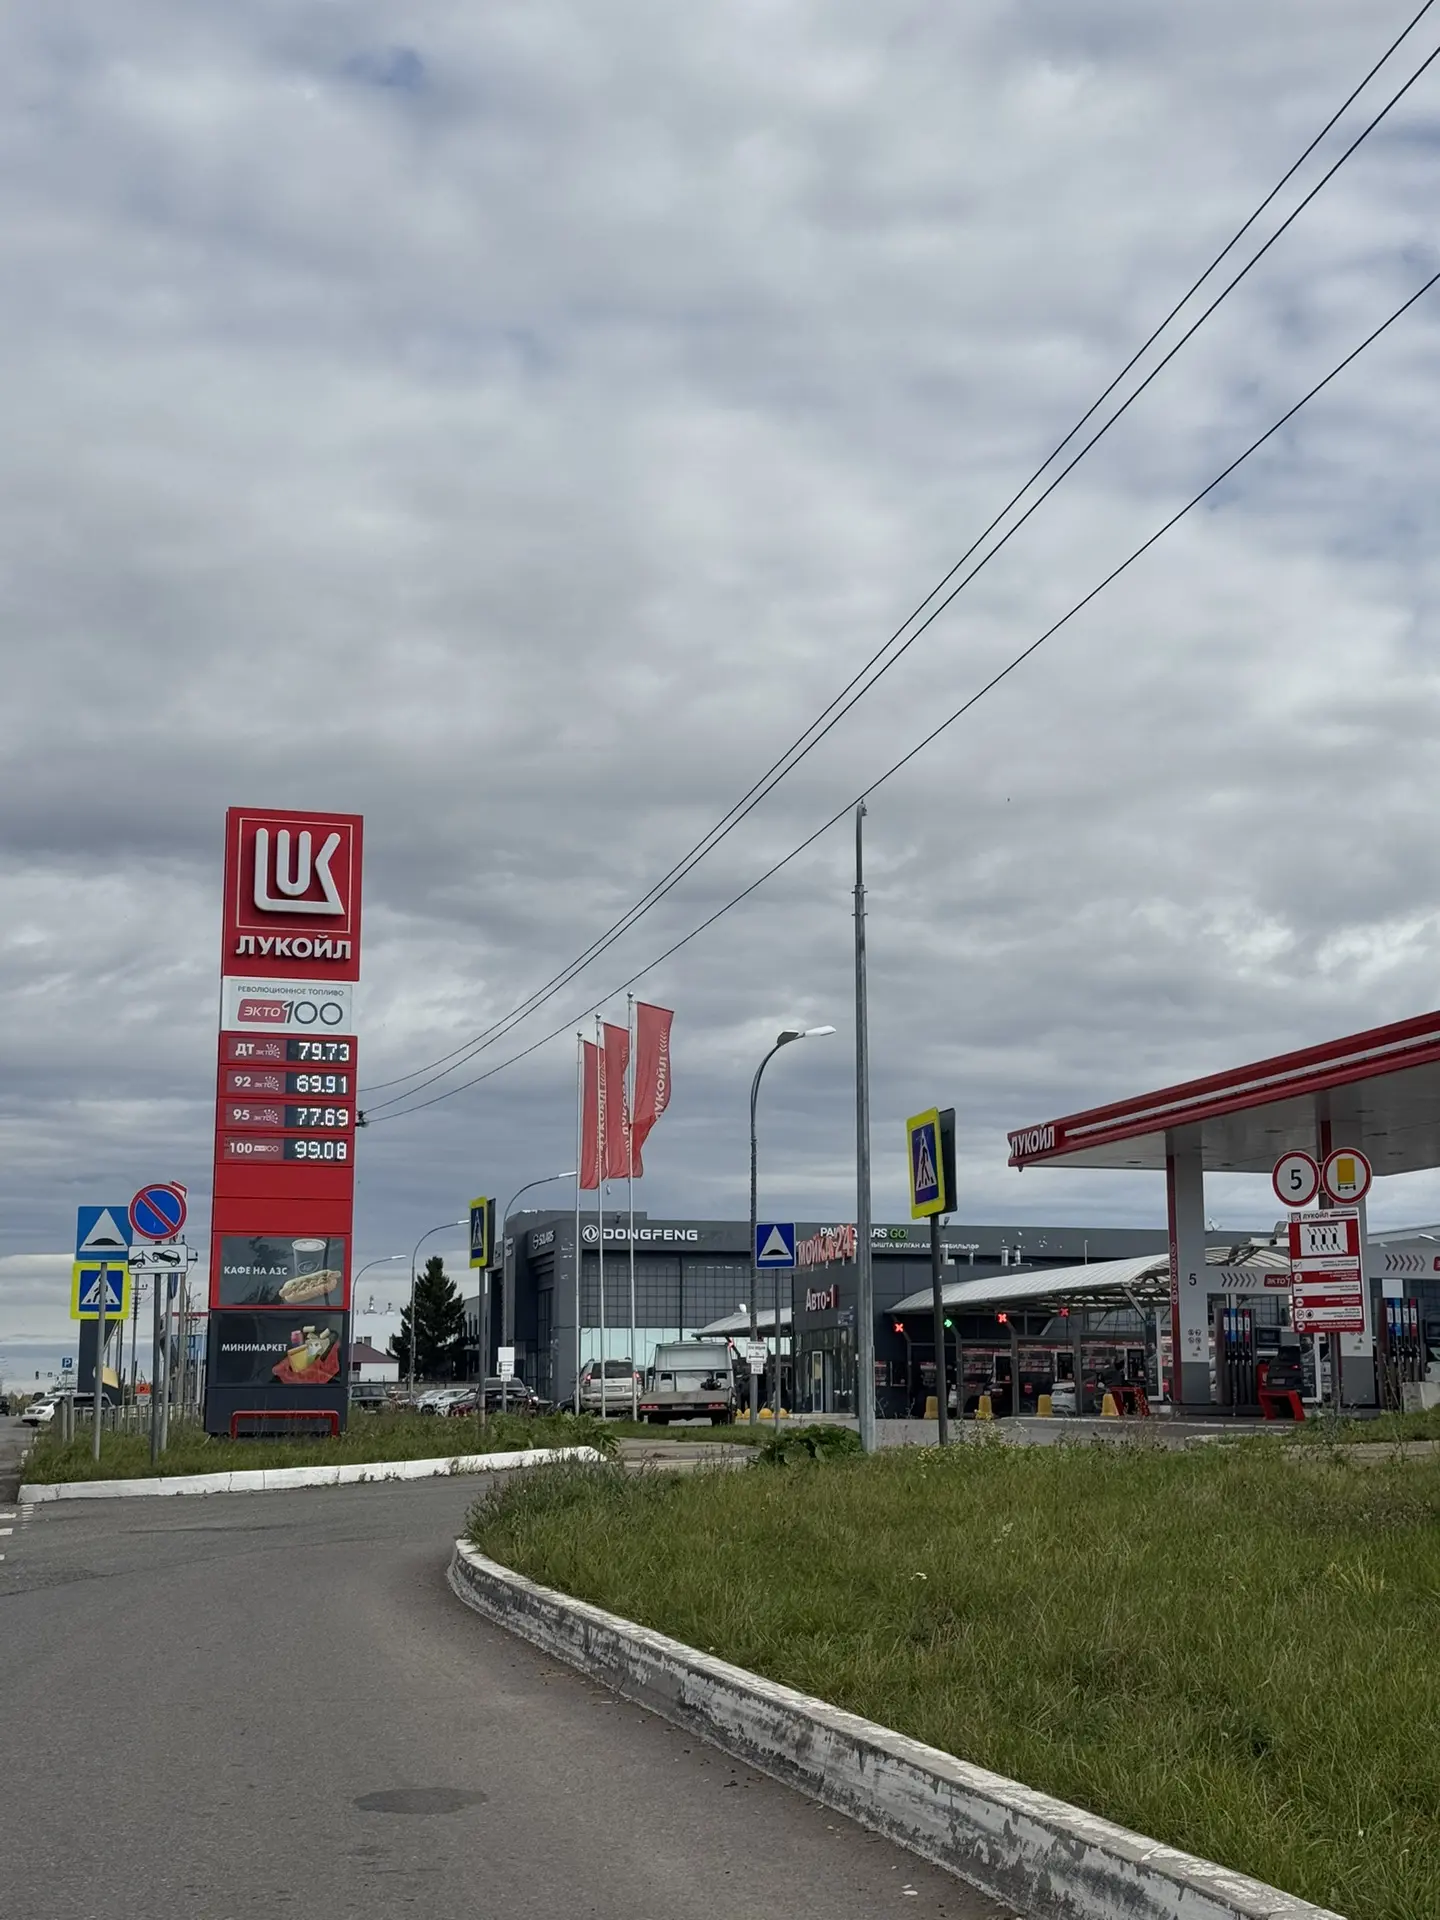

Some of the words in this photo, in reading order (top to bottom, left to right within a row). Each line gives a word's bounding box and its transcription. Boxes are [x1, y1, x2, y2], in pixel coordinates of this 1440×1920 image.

[235, 934, 352, 960] ЛУКОЙЛ
[237, 985, 306, 995] РЕВОЛЮЦИОННОЕ
[308, 988, 345, 997] ТОПЛИВО
[243, 1006, 281, 1018] ЭКТО
[235, 1043, 255, 1057] ДТ
[298, 1042, 350, 1061] 79.73
[234, 1075, 251, 1087] 92
[296, 1074, 347, 1094] 69.91
[233, 1108, 250, 1120] 95
[297, 1108, 349, 1127] 77.69
[1010, 1123, 1055, 1158] ЛУКОЙЛ
[230, 1142, 253, 1154] 100
[294, 1141, 347, 1160] 99.08
[1290, 1169, 1303, 1190] 5
[602, 1228, 698, 1241] DONGFENG
[834, 1223, 855, 1260] 24
[223, 1266, 251, 1275] КАФЕ
[253, 1266, 267, 1275] НА
[269, 1267, 288, 1275] АЗС
[1188, 1273, 1197, 1286] 5
[221, 1343, 288, 1352] МИНИМАРКЕТ
